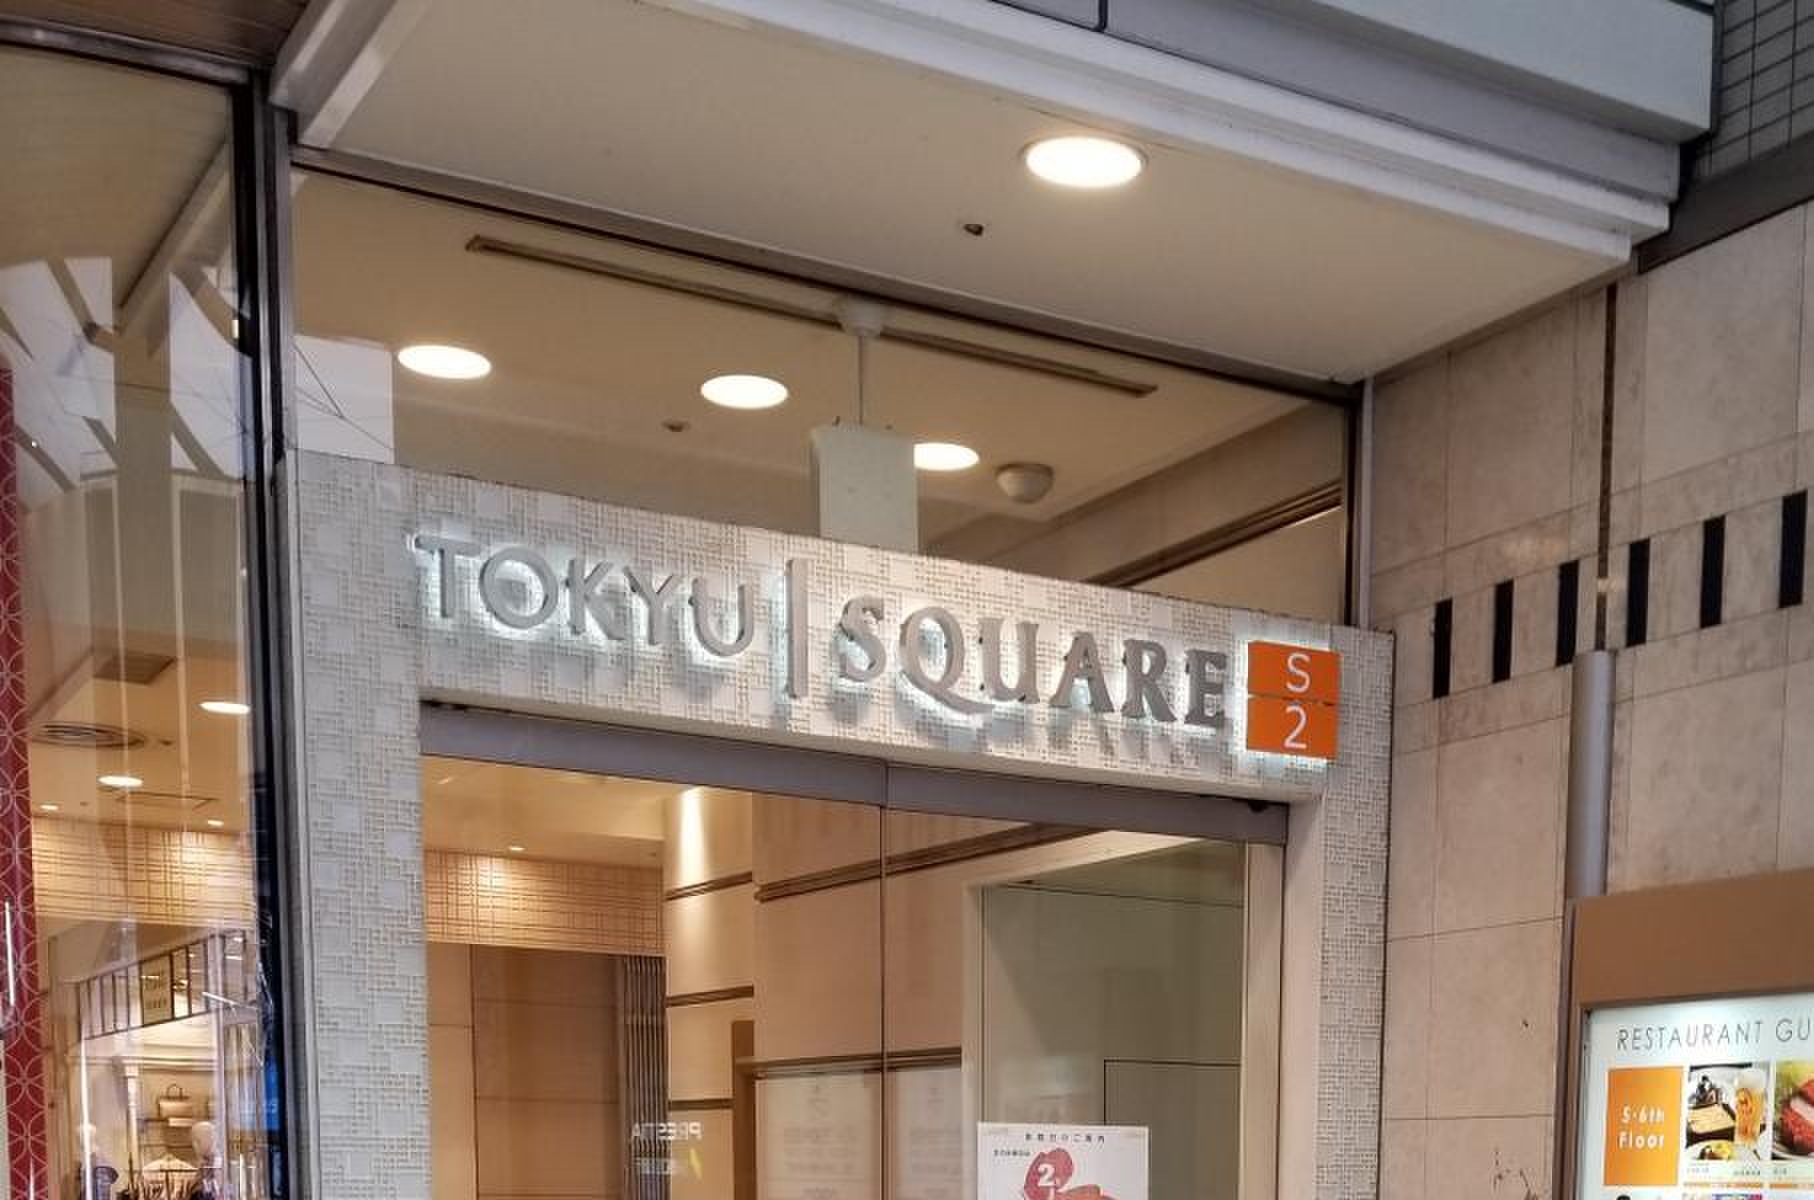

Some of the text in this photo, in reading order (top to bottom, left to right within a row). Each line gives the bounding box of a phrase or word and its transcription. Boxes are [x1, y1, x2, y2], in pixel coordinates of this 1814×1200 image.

[414, 532, 1228, 726] TOKYU SQUARE
[1286, 652, 1311, 693] S
[1284, 704, 1307, 749] 2
[1617, 1021, 1763, 1051] RESTAURANT
[1619, 1131, 1664, 1149] Floor
